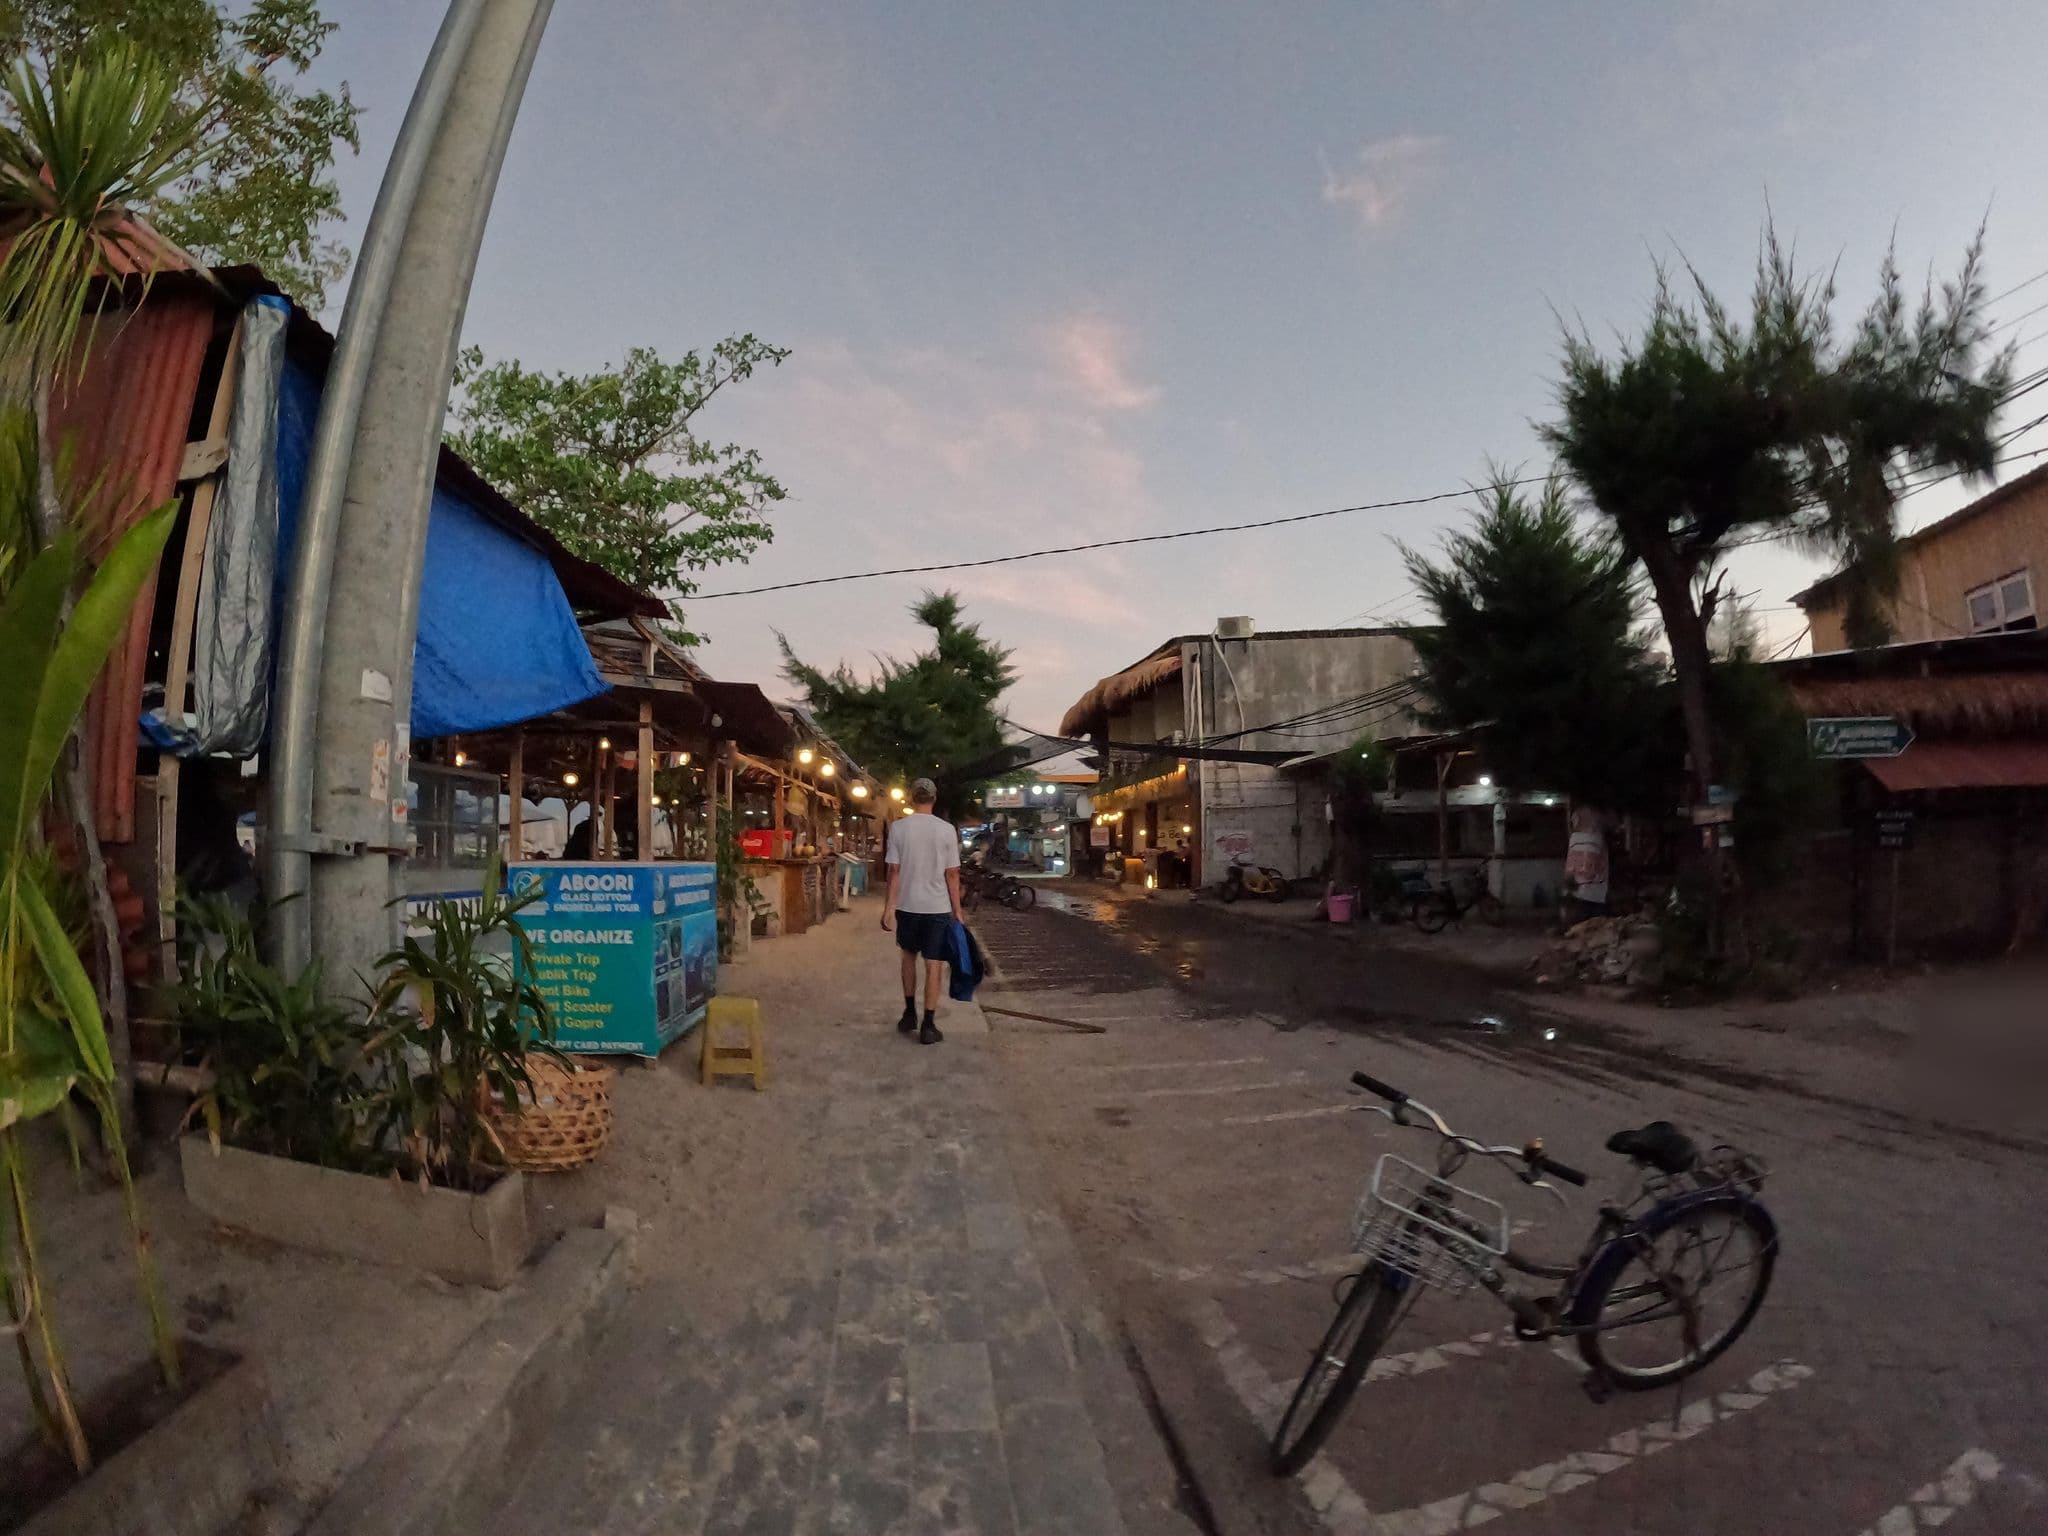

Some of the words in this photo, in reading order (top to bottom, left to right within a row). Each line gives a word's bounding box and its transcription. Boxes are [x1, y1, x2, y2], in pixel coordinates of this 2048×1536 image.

[560, 892, 590, 902] GLASS
[550, 929, 634, 944] ORGANIZE
[576, 952, 600, 967] Trip
[538, 969, 568, 980] ublik
[572, 968, 597, 983] Trip
[562, 984, 590, 997] Bike
[563, 1001, 613, 1013] Scooter
